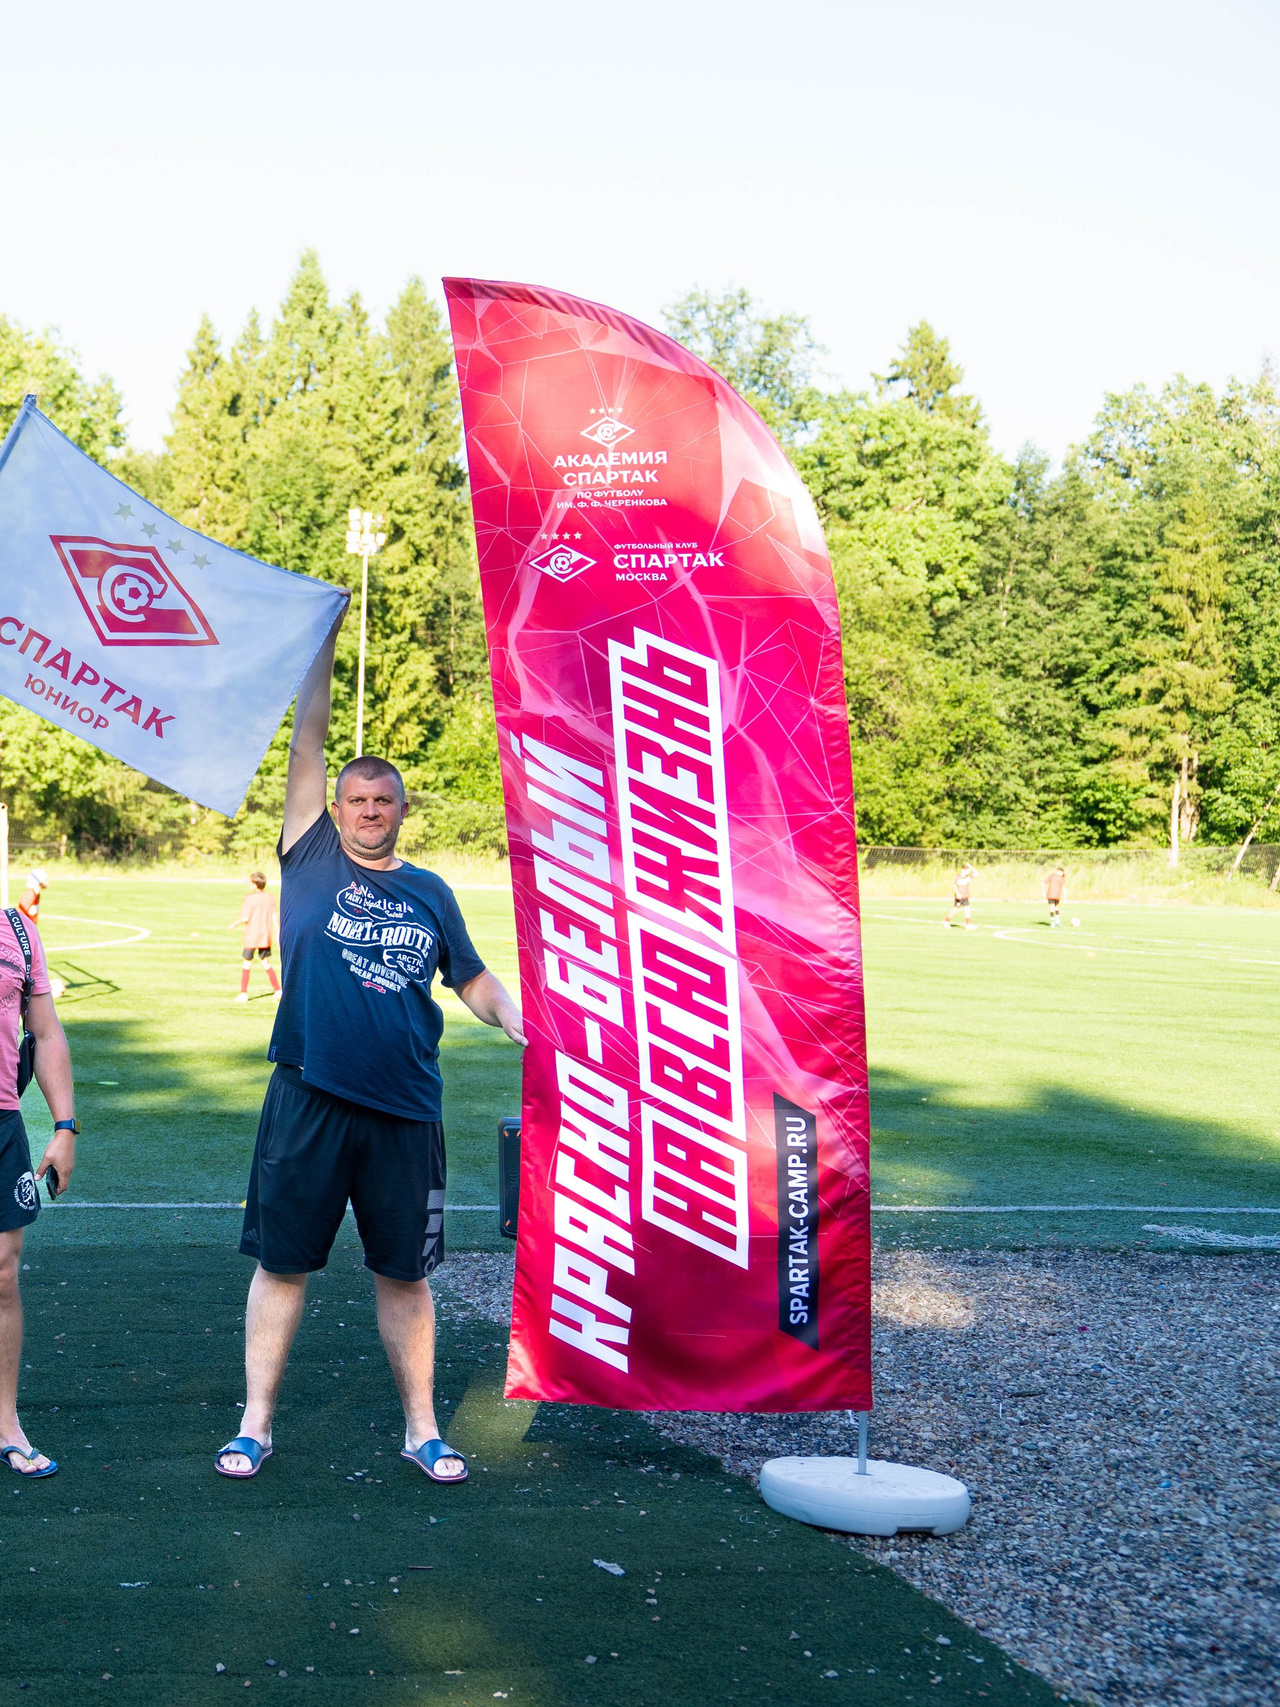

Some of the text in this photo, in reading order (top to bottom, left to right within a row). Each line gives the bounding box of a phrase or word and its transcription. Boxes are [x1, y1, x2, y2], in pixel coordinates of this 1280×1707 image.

[553, 451, 668, 468] АКАДЕМИЯ
[563, 470, 659, 486] СПАРТАК
[576, 489, 644, 499] ПО ФУТБОЛУ
[556, 501, 576, 509] ИМ.
[590, 500, 603, 508] Ф.
[604, 498, 668, 508] ЧЕРЕНКОВА
[613, 542, 674, 550] ФУТБОЛЬНЫЙ
[613, 552, 725, 569] СПАРТАК
[615, 573, 668, 581] МОСКВА
[23, 673, 110, 730] ЮНИОР
[11, 916, 31, 956] CULTURE
[380, 926, 433, 958] ROUTE
[614, 635, 742, 1259] НА ВСЮ ЖИЗНЬ
[341, 948, 370, 969] GREAT
[397, 953, 424, 967] ARCTIC
[349, 964, 373, 980] OCEAN
[406, 964, 420, 975] SEA
[781, 1114, 811, 1327] SPARTAK-CAMP.RU
